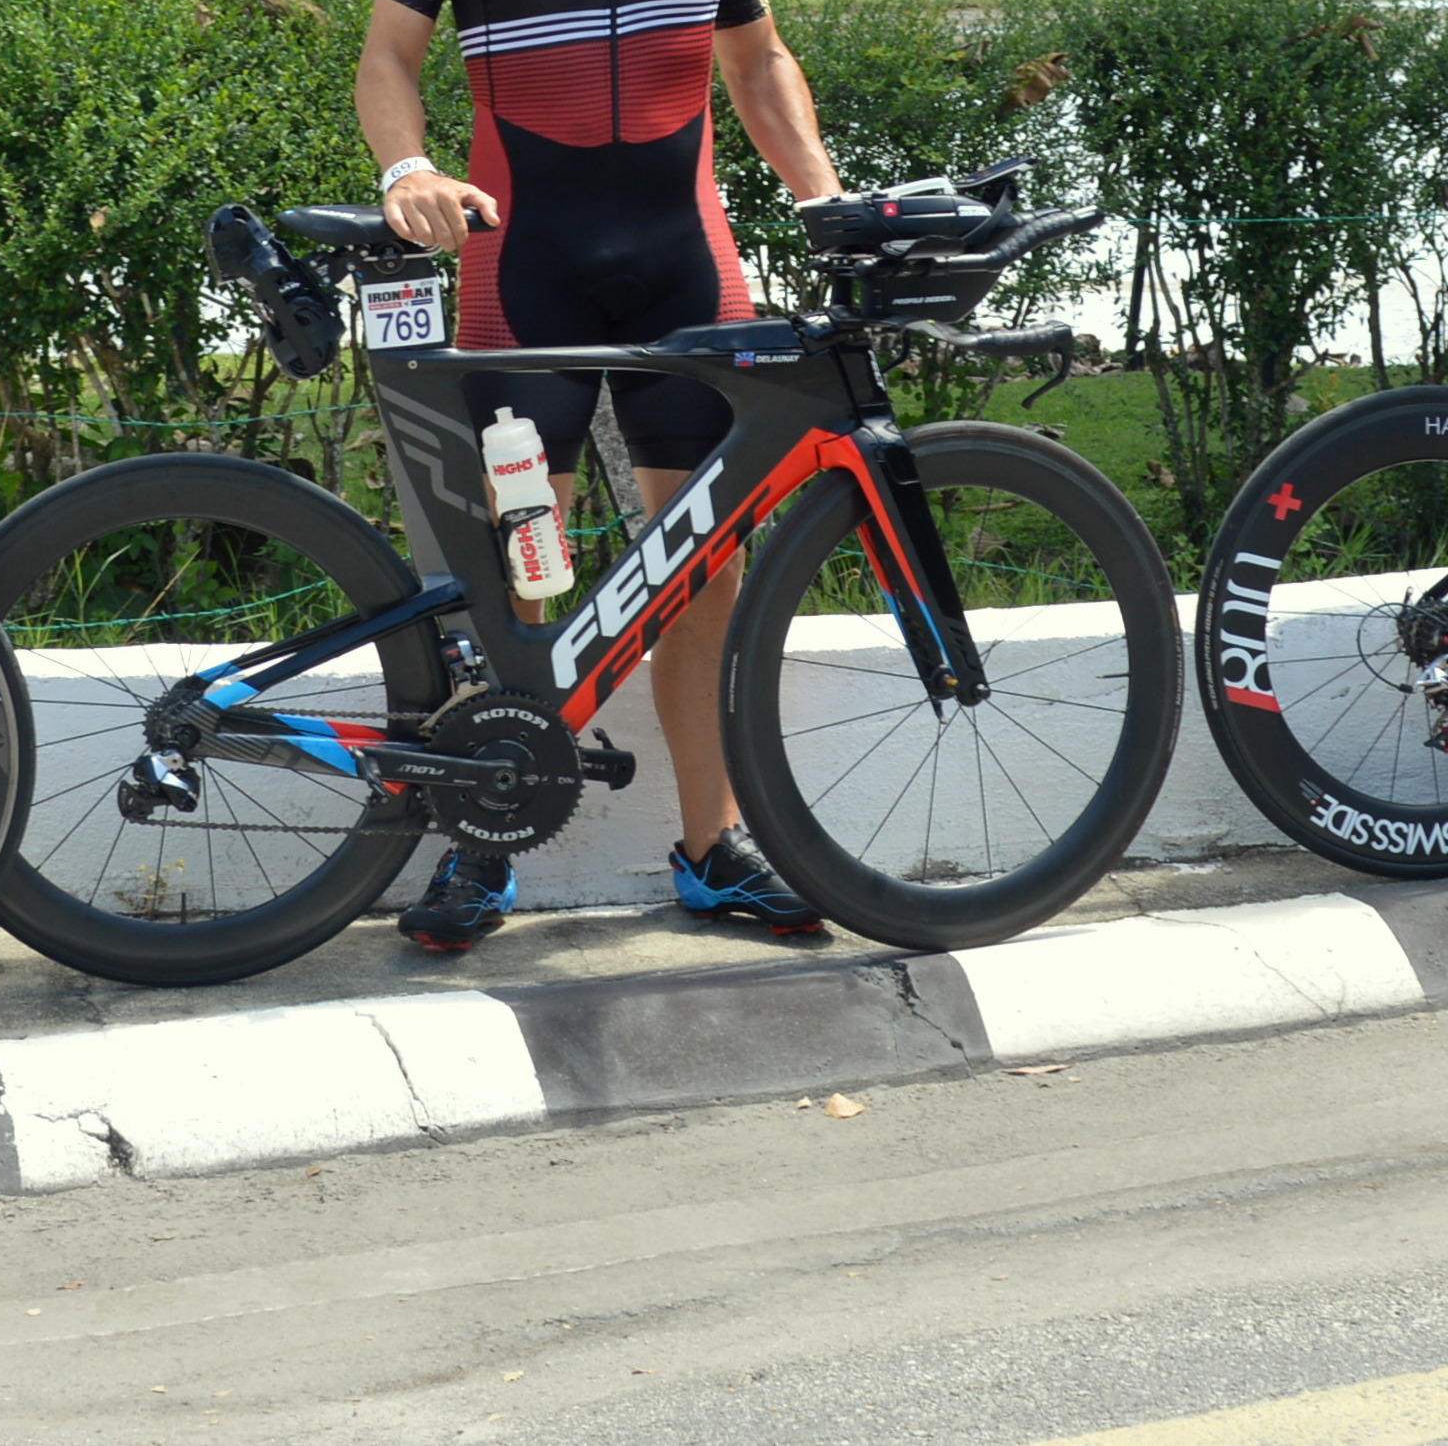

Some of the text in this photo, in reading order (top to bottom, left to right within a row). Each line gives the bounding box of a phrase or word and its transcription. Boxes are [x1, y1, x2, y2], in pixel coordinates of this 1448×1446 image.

[368, 286, 434, 305] IRONMAN
[376, 308, 431, 343] 769
[755, 354, 800, 364] DELAUNAY
[551, 457, 724, 689] FELT
[471, 707, 550, 731] ROTOR
[457, 819, 536, 843] ROTOR
